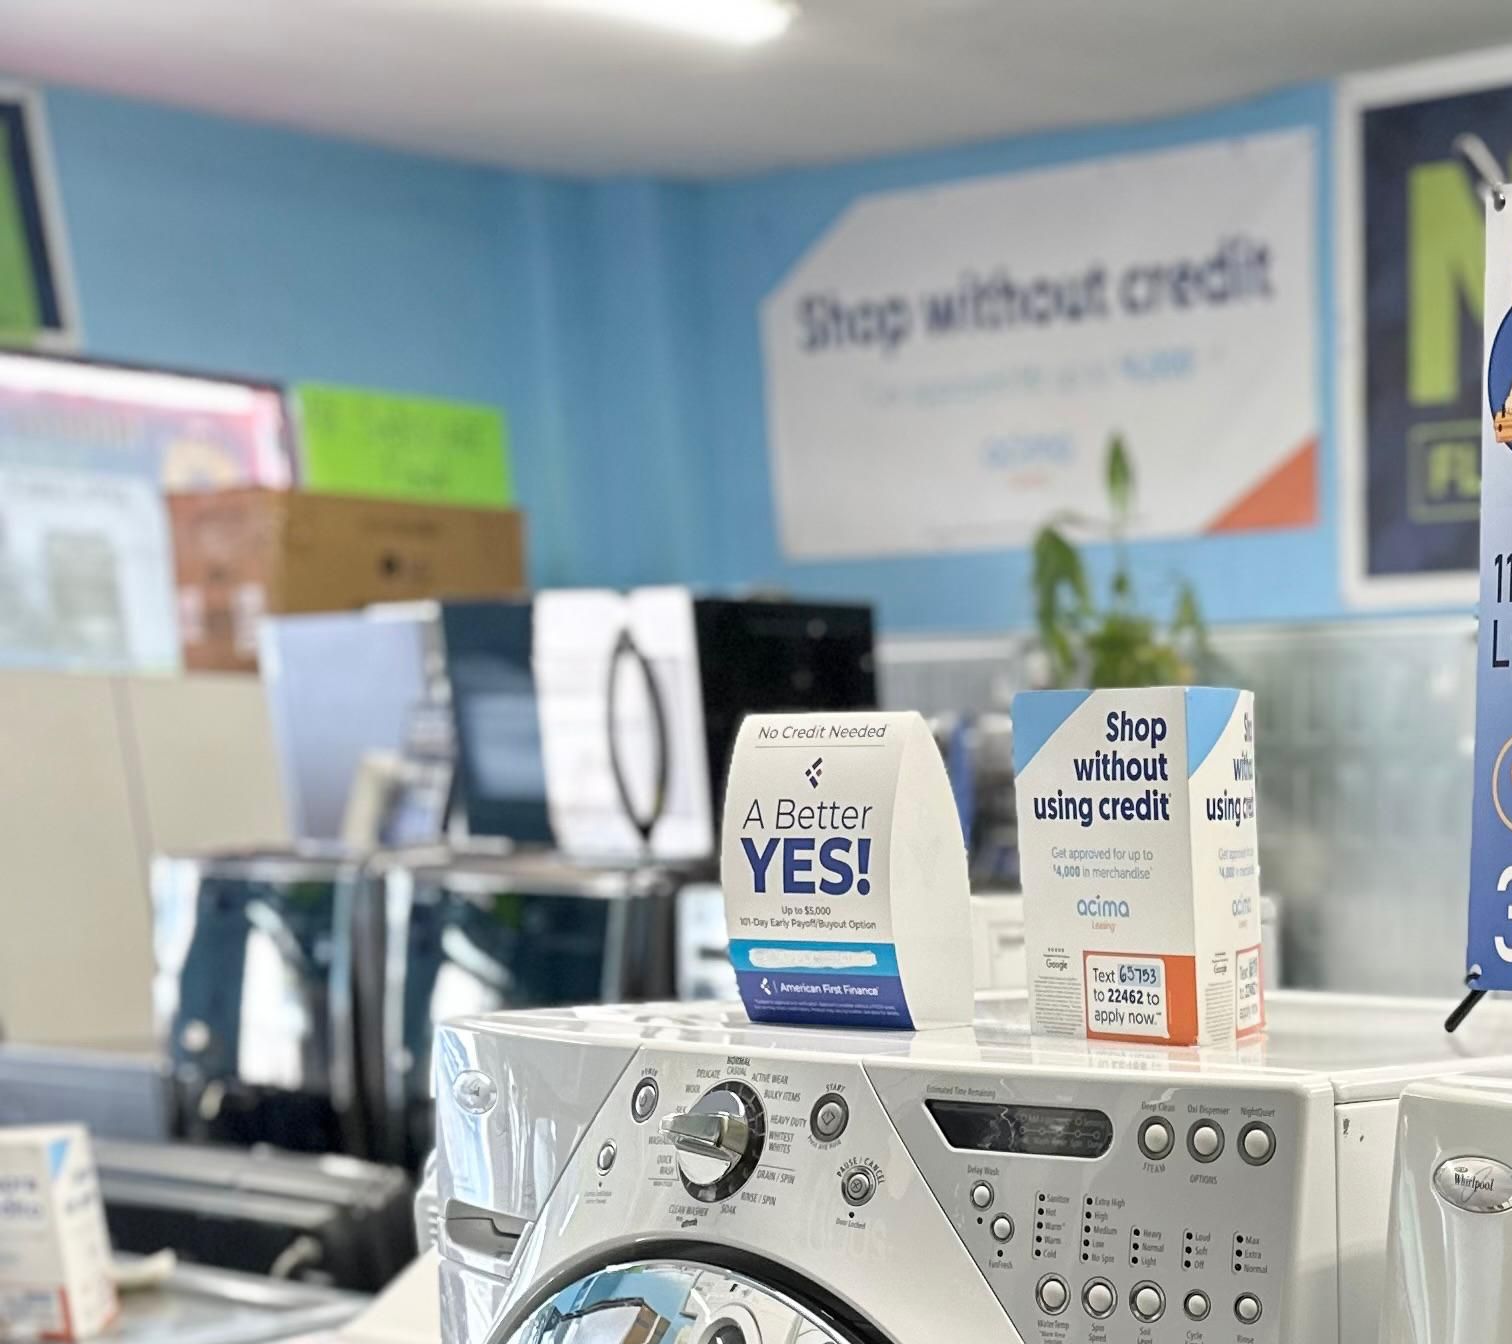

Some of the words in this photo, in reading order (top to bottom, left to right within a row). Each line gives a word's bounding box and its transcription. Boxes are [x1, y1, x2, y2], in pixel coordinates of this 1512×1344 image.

[925, 264, 1106, 336] without
[1121, 233, 1275, 315] credit
[758, 726, 779, 740] No
[782, 725, 826, 740] Credit
[1105, 710, 1168, 749] Shop
[1073, 750, 1169, 782] without
[742, 799, 765, 830] A
[775, 798, 873, 830] Better
[1033, 789, 1094, 828] using
[1100, 789, 1171, 821] credit
[1206, 789, 1241, 827] using
[1051, 847, 1067, 859] Get
[1068, 848, 1111, 861] approved
[1112, 848, 1126, 860] for
[1128, 850, 1141, 862] up
[1142, 849, 1154, 861] to
[740, 837, 872, 896] YES!
[1082, 865, 1091, 877] in
[781, 906, 793, 916] Up
[794, 906, 803, 915] to
[1077, 894, 1130, 917] acima
[770, 918, 790, 929] Early
[848, 919, 877, 931] Option
[1046, 959, 1068, 971] Google
[1092, 967, 1116, 983] Text
[780, 982, 822, 994] American
[823, 983, 843, 995] First
[1093, 988, 1105, 1002] to
[1107, 988, 1143, 1005] 22462
[1147, 991, 1160, 1006] to
[1094, 1008, 1125, 1026] apply
[825, 1083, 846, 1093] START
[1141, 1101, 1157, 1113] Deep
[1158, 1102, 1176, 1113] Clean
[967, 1164, 983, 1176] Delay
[1142, 1162, 1166, 1174] STEAM
[1189, 1174, 1218, 1185] OPTIONS
[1454, 1172, 1494, 1192] Whirlpool
[1245, 1236, 1260, 1245] Max
[1244, 1250, 1262, 1260] Extra
[1244, 1264, 1268, 1274] Normal
[1186, 1330, 1203, 1341] Cycle
